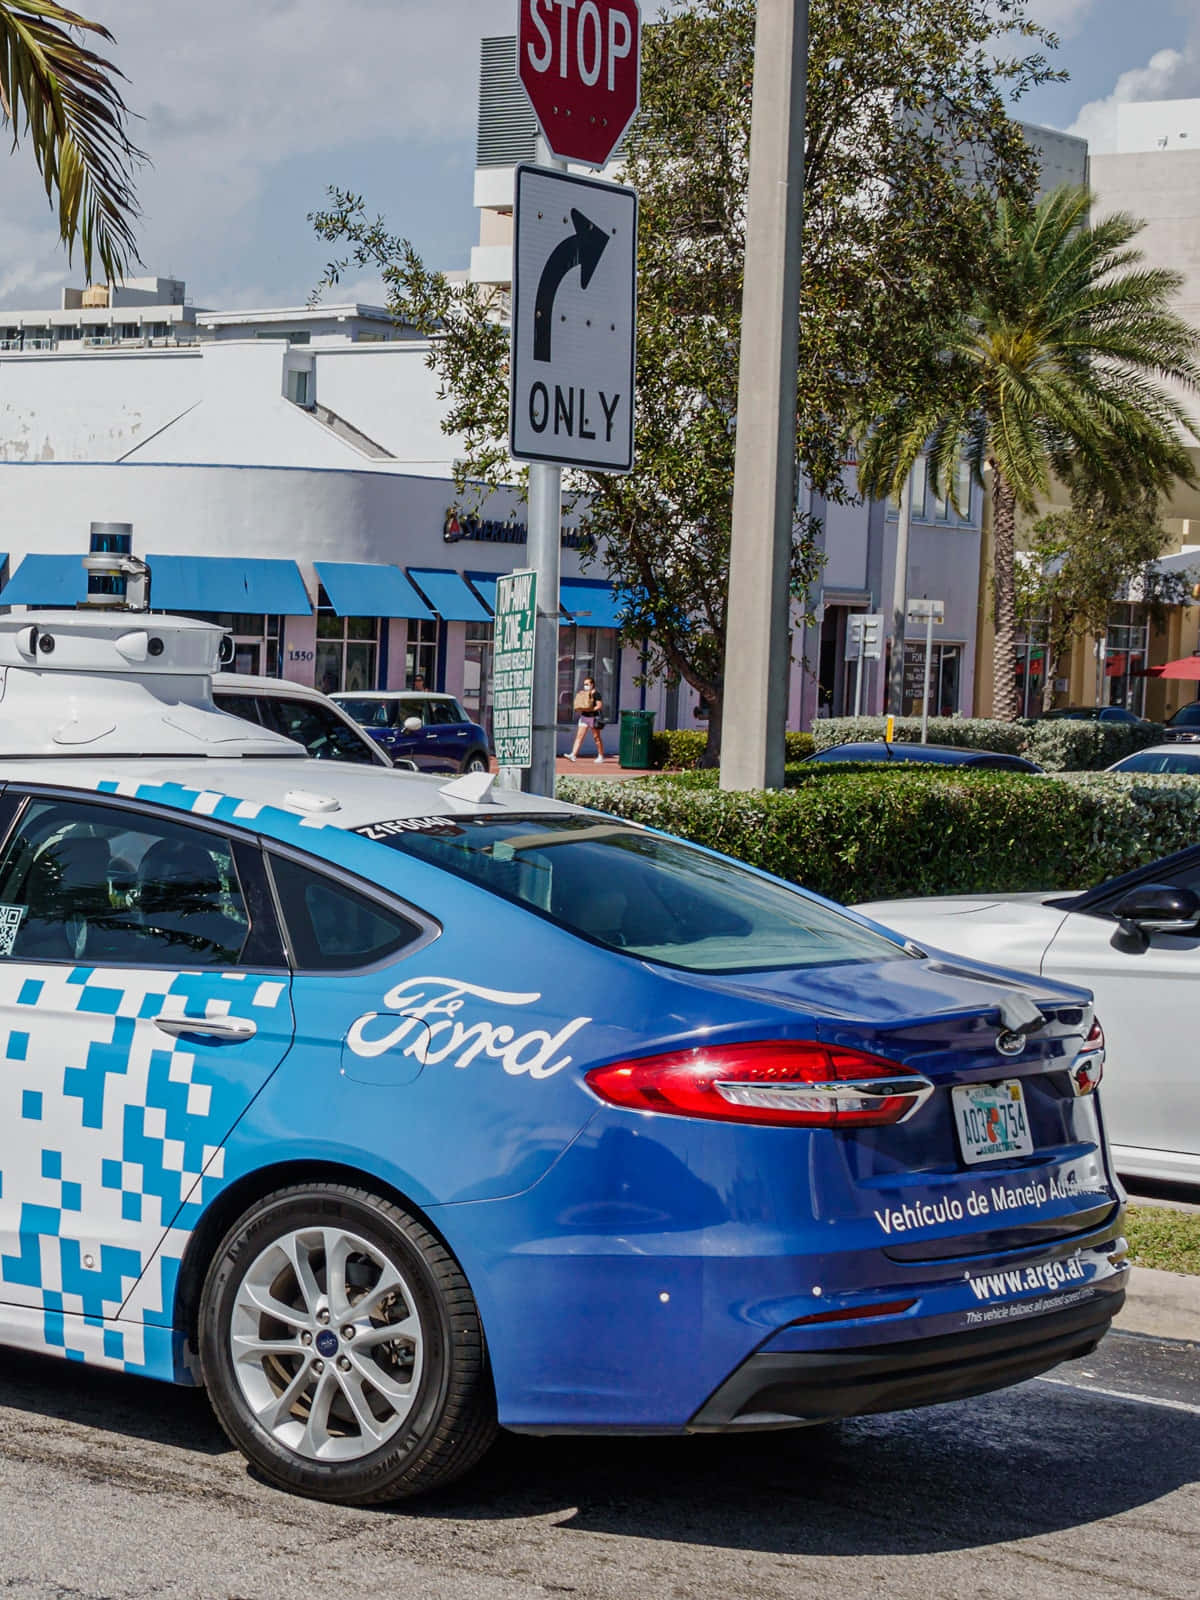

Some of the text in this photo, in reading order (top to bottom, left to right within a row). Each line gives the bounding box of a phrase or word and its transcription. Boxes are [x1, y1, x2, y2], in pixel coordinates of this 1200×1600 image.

[527, 0, 632, 92] STOP
[529, 381, 620, 442] ONLY
[356, 816, 456, 840] Z1F0040
[346, 976, 593, 1080] Ford
[874, 1196, 964, 1235] Vehículo
[967, 1190, 989, 1216] de
[991, 1178, 1047, 1211] Manejo
[969, 1249, 1085, 1299] www.argo.ai
[966, 1310, 983, 1324] This
